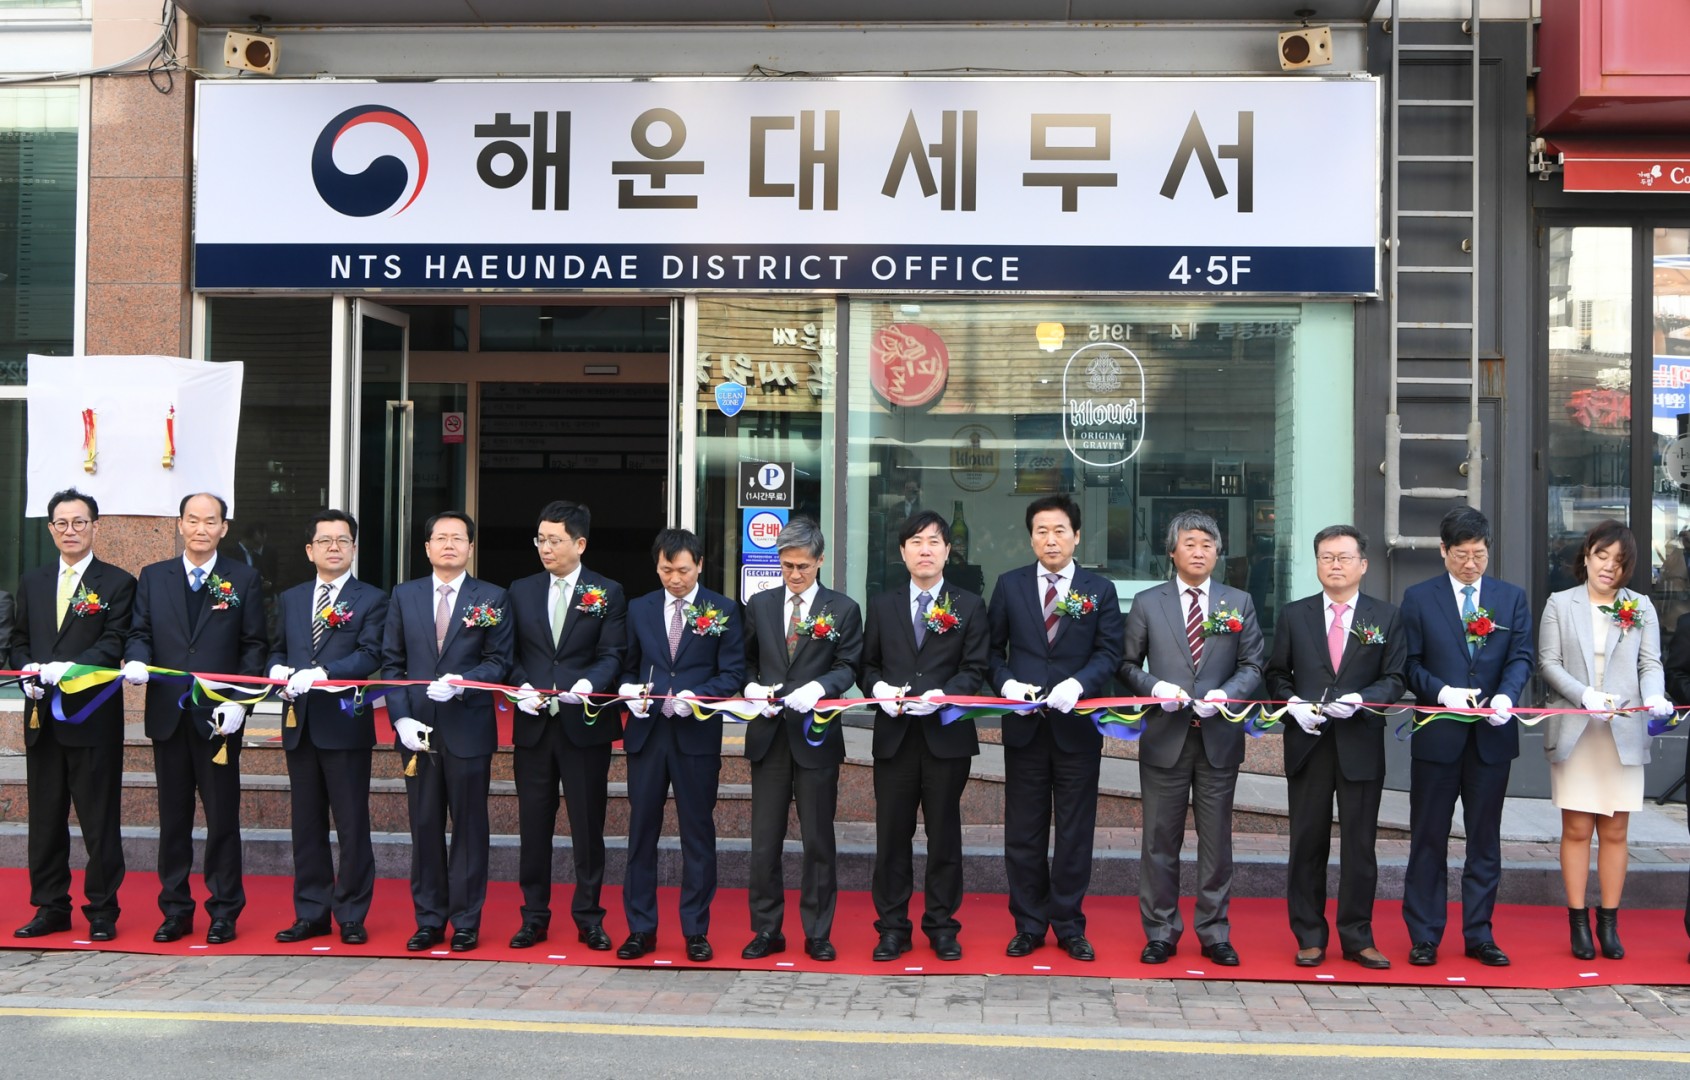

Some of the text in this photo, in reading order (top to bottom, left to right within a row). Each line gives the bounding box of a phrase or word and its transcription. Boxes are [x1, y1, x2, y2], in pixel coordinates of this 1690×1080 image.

[474, 108, 1253, 212] 해운대세무서
[330, 254, 401, 279] NTS
[426, 255, 637, 280] HAEUNDAE
[663, 254, 848, 280] DISTRICT
[872, 255, 1019, 282] OFFICE
[1081, 432, 1127, 441] ORIGINAL
[1083, 441, 1125, 449] GRAVITY
[764, 468, 779, 486] P
[745, 492, 787, 501] (1시간무료)
[752, 523, 780, 537] 담배
